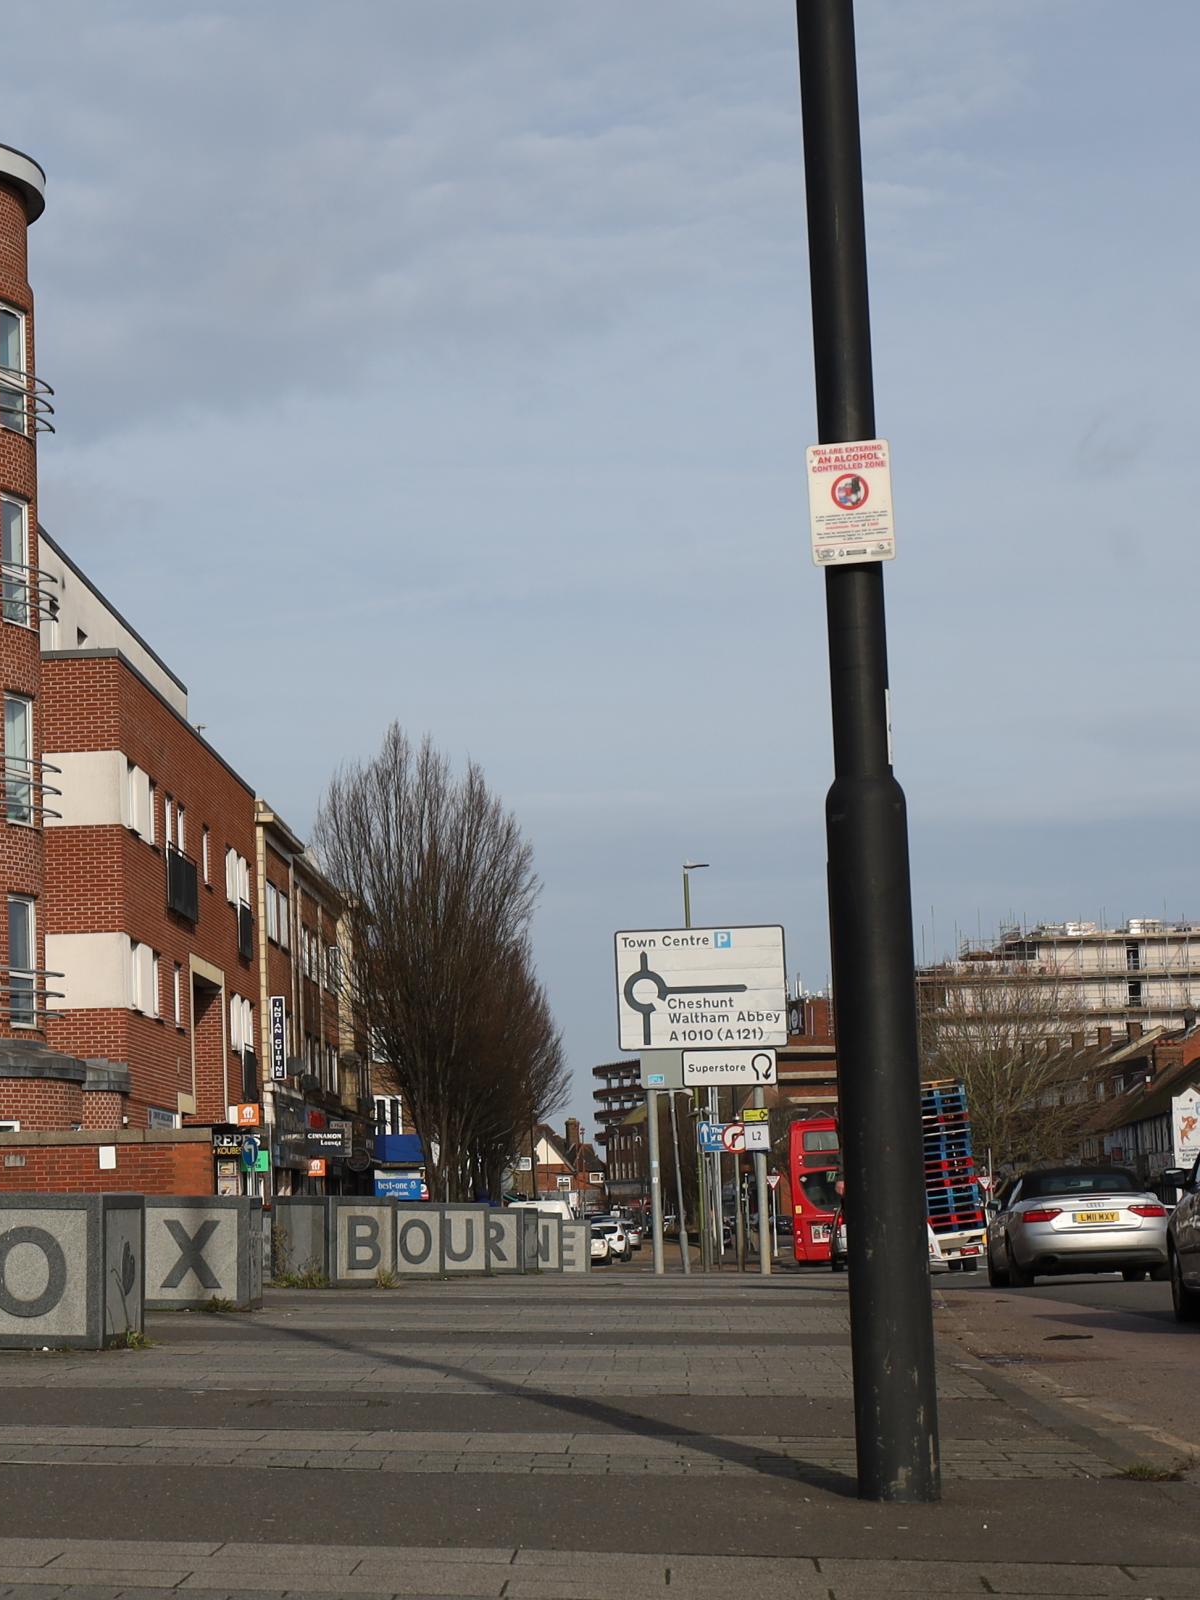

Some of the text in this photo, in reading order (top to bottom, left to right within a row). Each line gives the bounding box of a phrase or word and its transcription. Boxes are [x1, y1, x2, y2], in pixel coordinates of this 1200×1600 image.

[812, 444, 882, 456] YOU ARE ENTERING
[818, 452, 880, 464] AN ALCOHOL
[812, 460, 886, 473] CONTROLLED ZONE
[622, 937, 656, 948] Town
[662, 936, 709, 947] Centre
[667, 997, 734, 1010] Cheshunt
[274, 1001, 282, 1033] INDIAN
[668, 1012, 729, 1024] Waltham
[737, 1011, 780, 1023] Abbey
[275, 1039, 283, 1077] CUISINE
[688, 1063, 746, 1073] Superstore
[752, 1131, 762, 1141] L2
[377, 1181, 407, 1190] best-one
